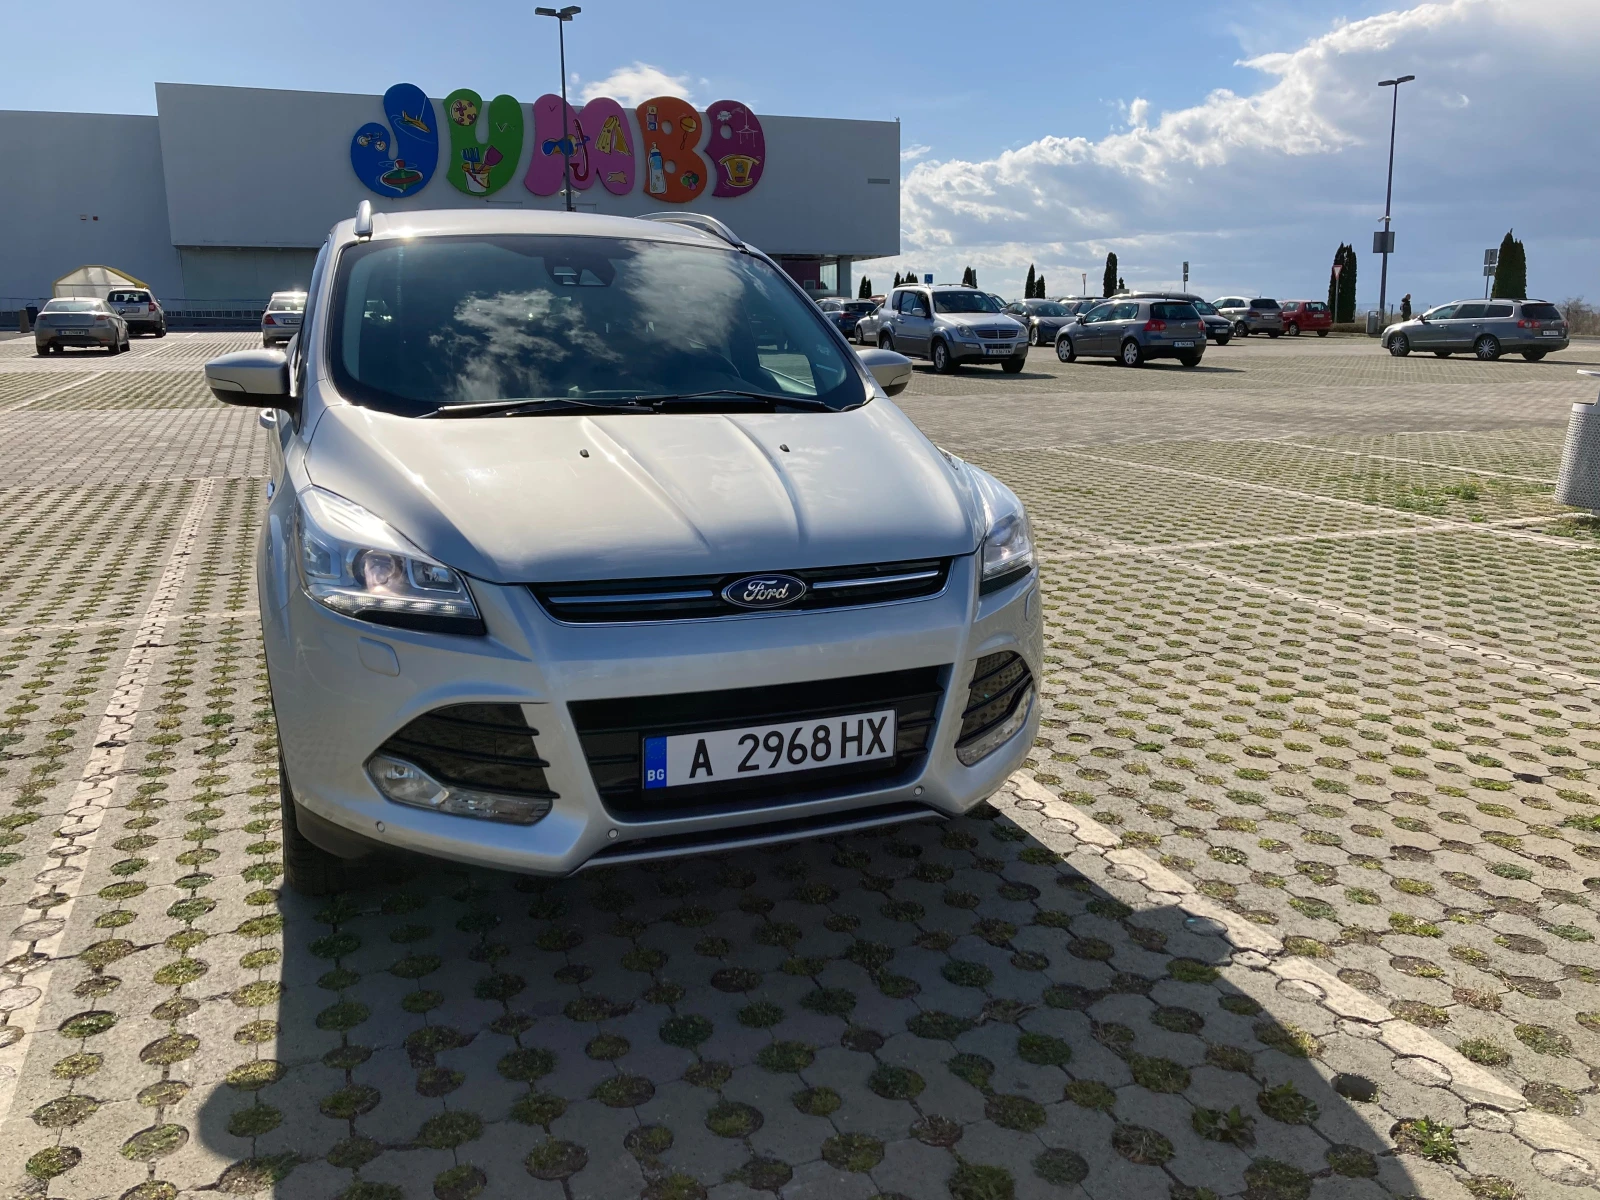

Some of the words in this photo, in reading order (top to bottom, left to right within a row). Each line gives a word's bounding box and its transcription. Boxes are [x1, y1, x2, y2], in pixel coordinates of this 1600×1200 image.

[350, 82, 766, 203] JUMBO
[743, 579, 789, 602] Ford
[689, 738, 714, 779] A
[737, 724, 832, 773] 2968
[840, 716, 888, 759] HX
[647, 768, 665, 782] BG
